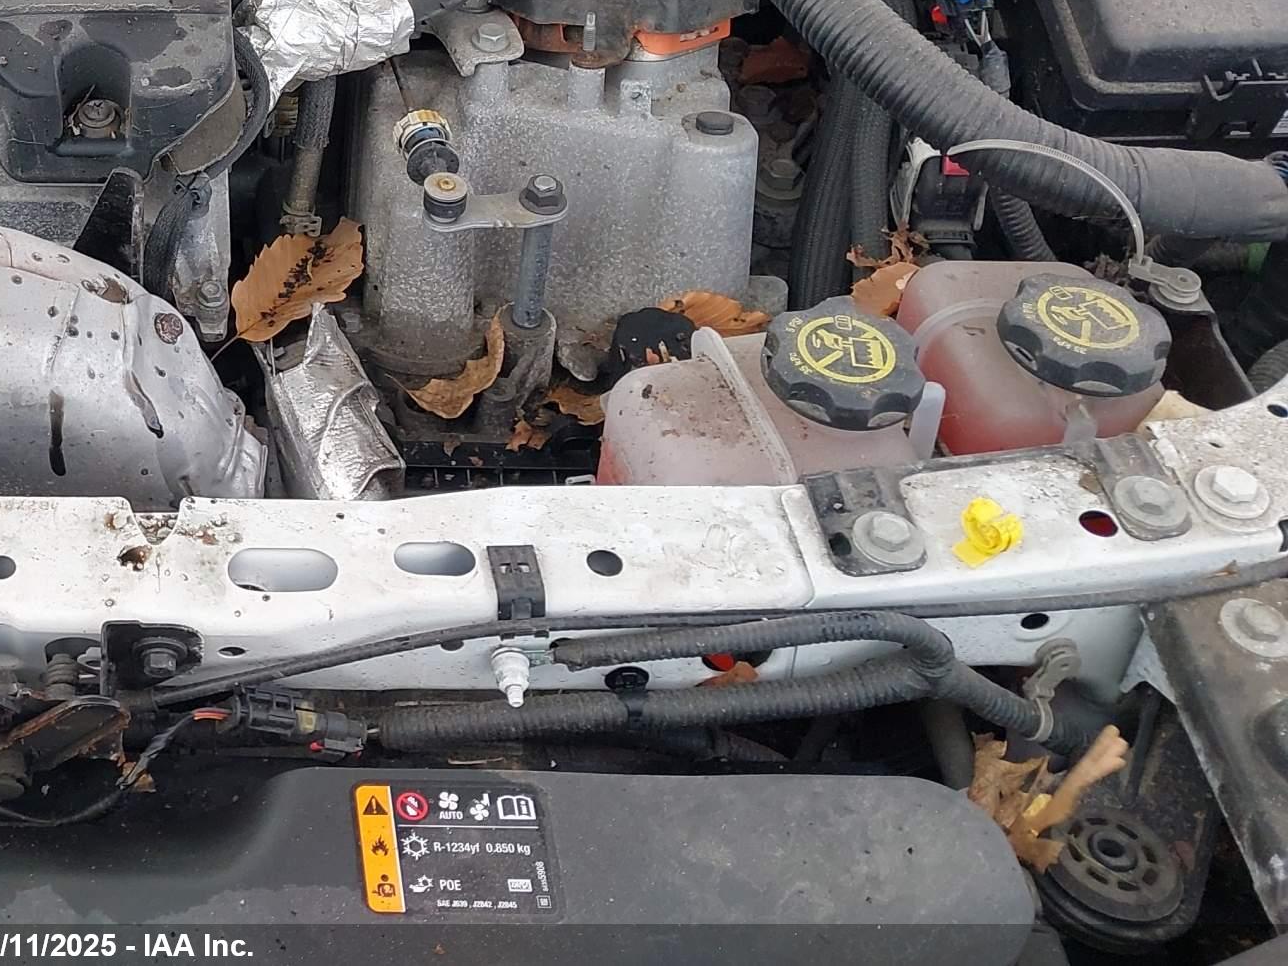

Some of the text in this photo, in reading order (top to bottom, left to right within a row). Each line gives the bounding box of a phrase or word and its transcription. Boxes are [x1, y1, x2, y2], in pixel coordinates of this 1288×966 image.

[439, 811, 463, 820] AUTO
[433, 842, 531, 856] R-1234yf 0.850 kg
[440, 879, 462, 891] POE
